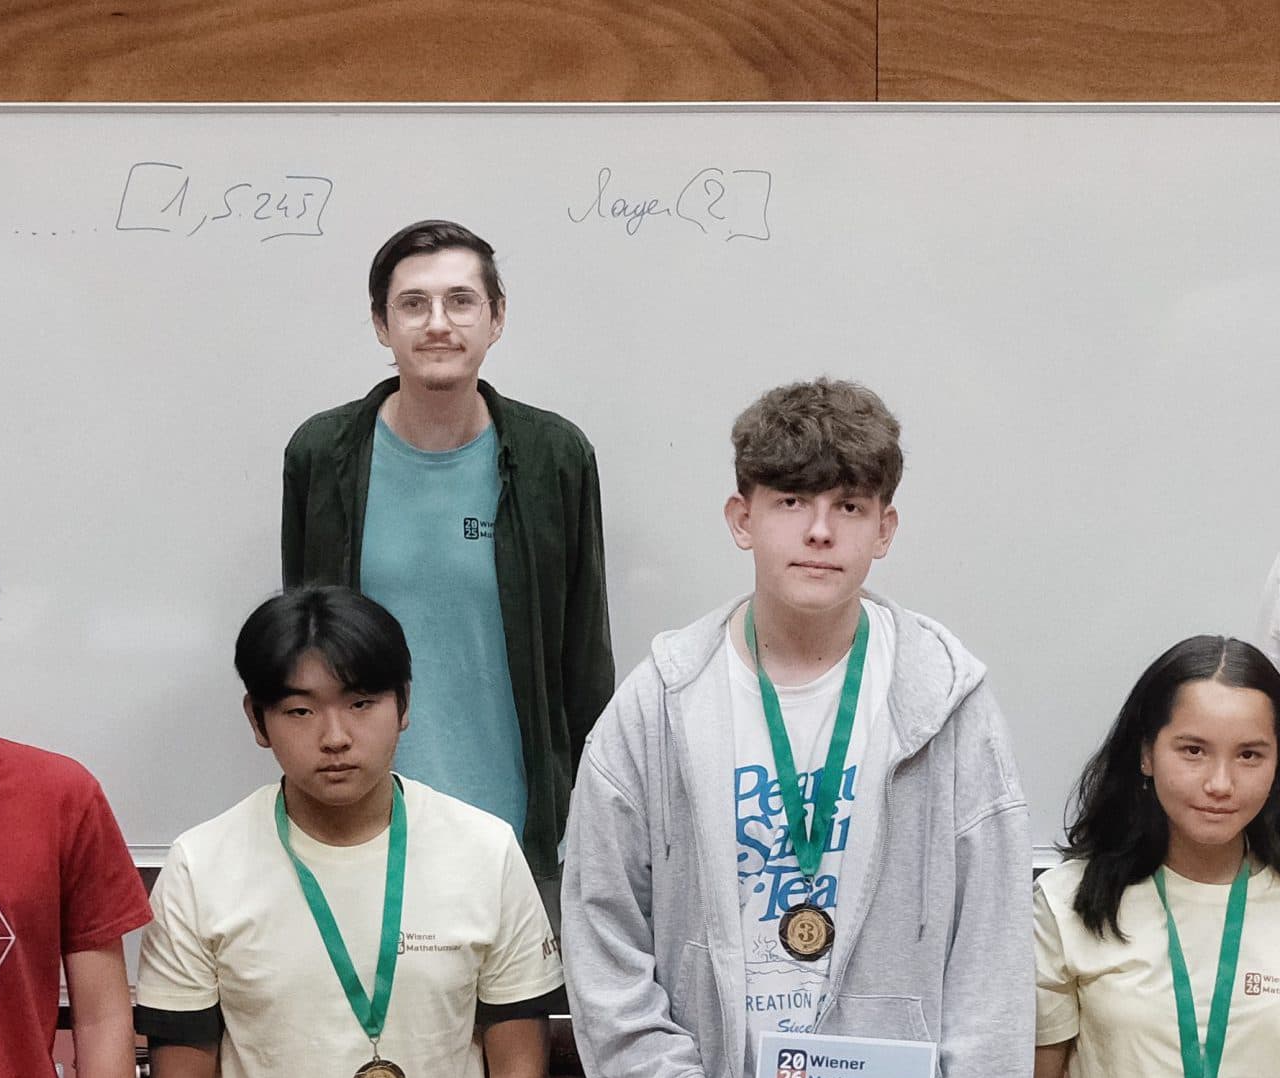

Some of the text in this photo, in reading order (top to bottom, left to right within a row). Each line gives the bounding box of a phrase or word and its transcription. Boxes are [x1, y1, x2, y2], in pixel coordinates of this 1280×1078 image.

[754, 866, 837, 921] Tea
[798, 922, 815, 942] 3
[779, 1052, 865, 1070] 20 Wiener
